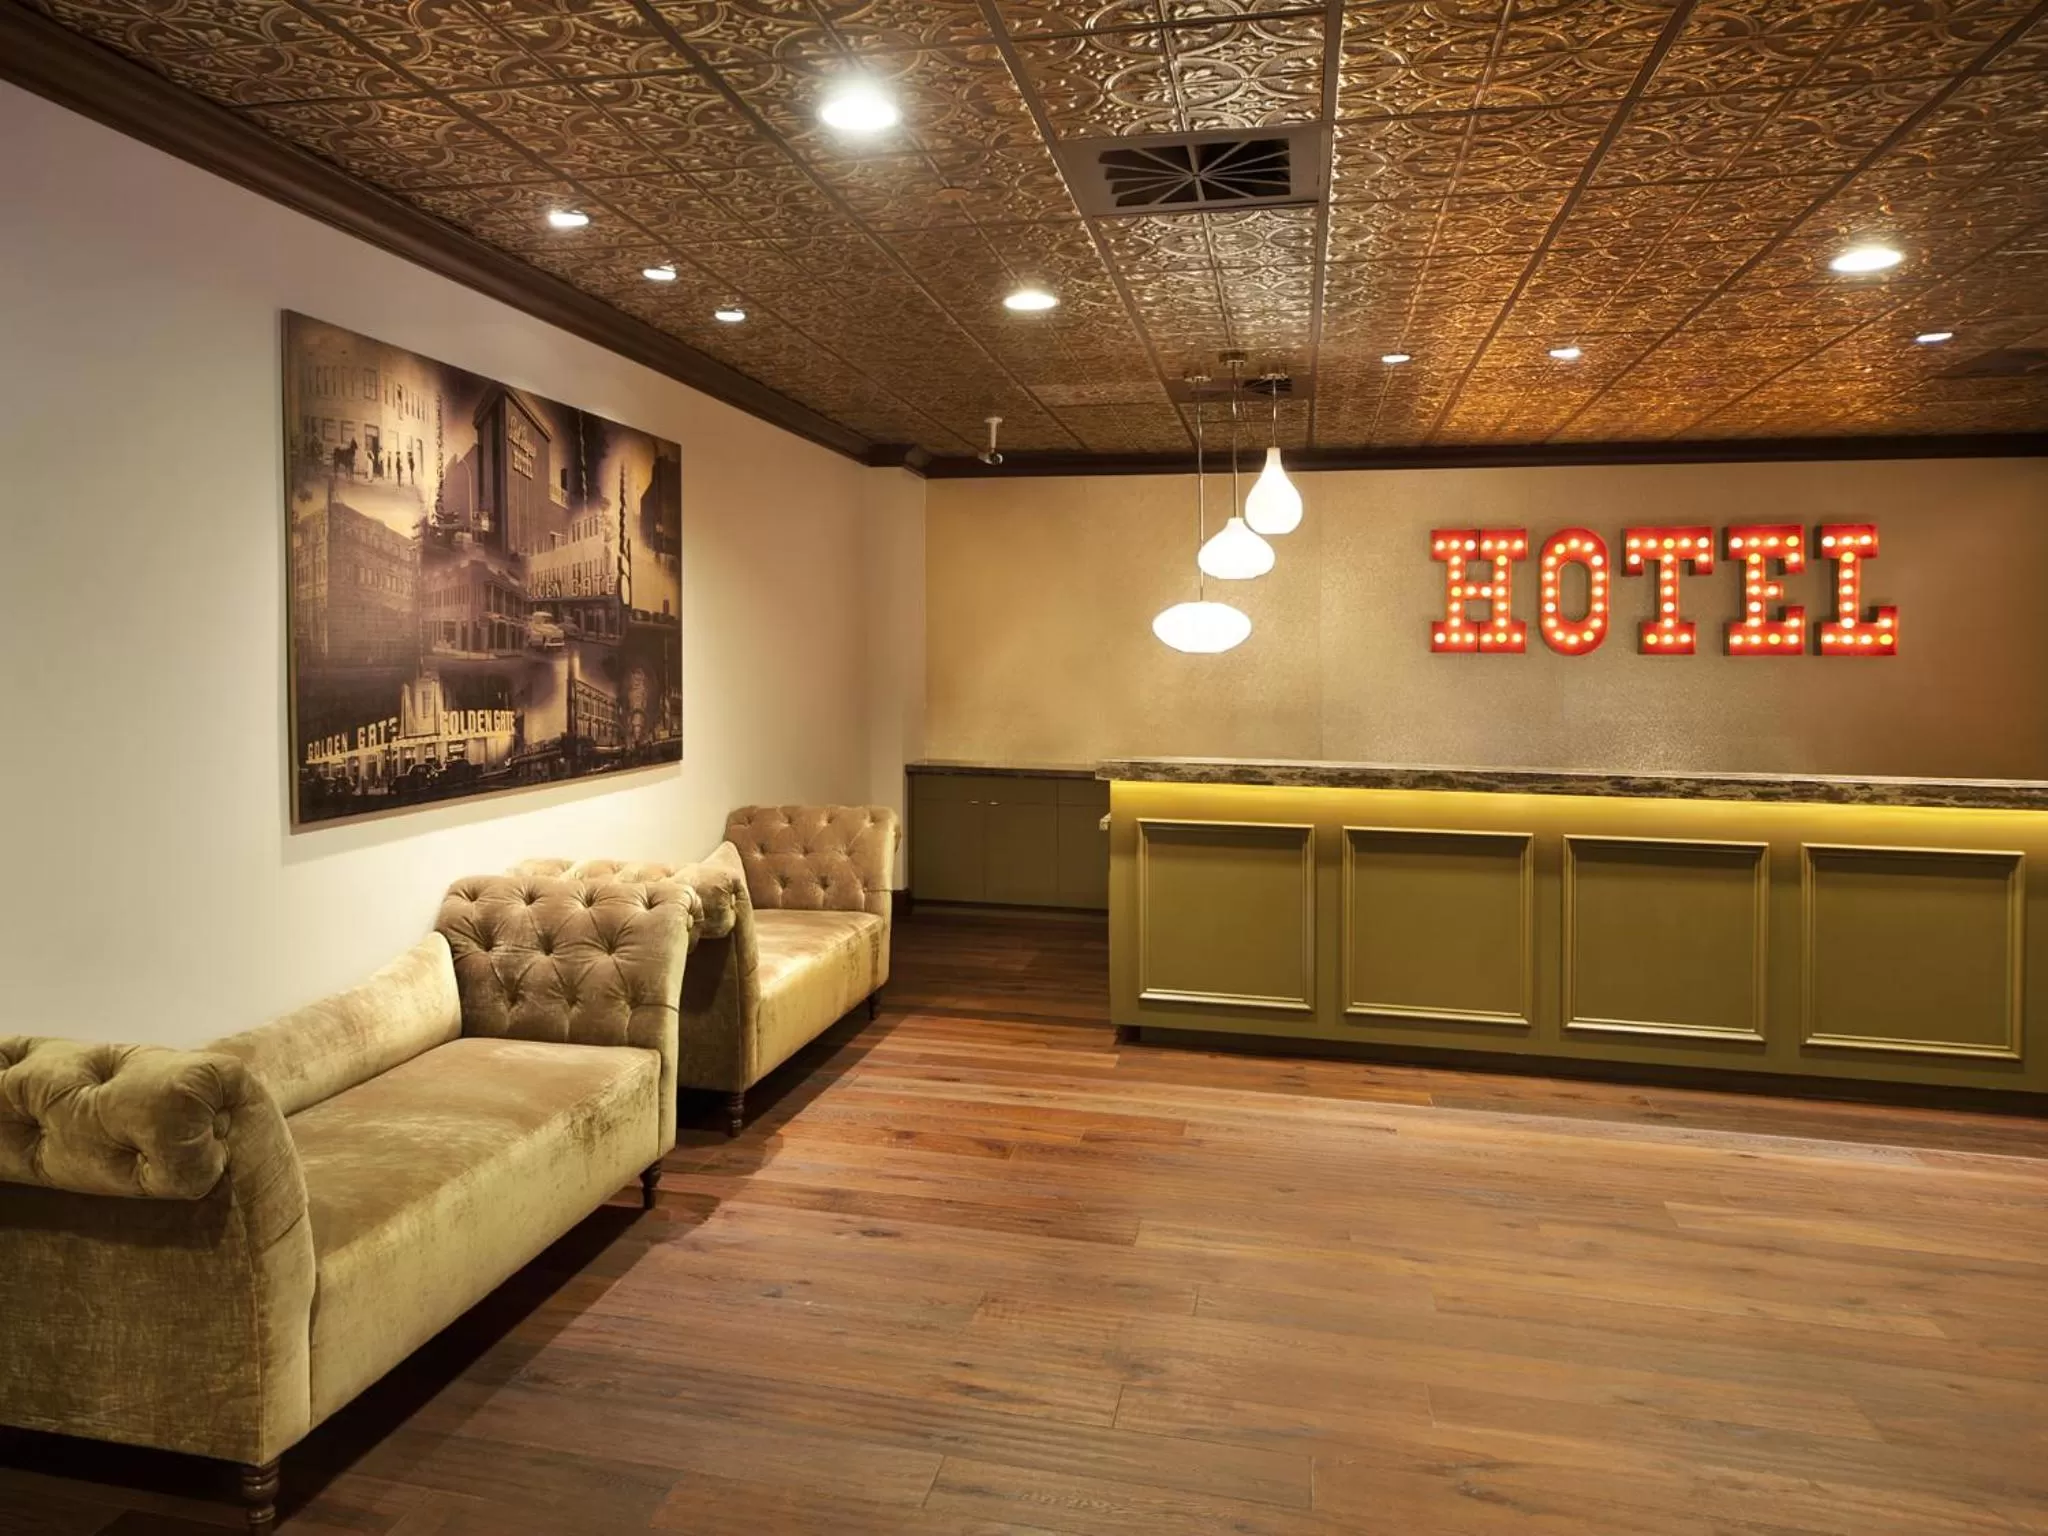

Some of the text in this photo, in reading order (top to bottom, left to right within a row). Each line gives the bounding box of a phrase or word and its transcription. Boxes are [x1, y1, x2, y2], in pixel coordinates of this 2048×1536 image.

[571, 573, 617, 597] GATE
[1431, 524, 1897, 656] HOTEL
[439, 709, 491, 735] GOLDEN
[307, 732, 348, 760] GOLDEN
